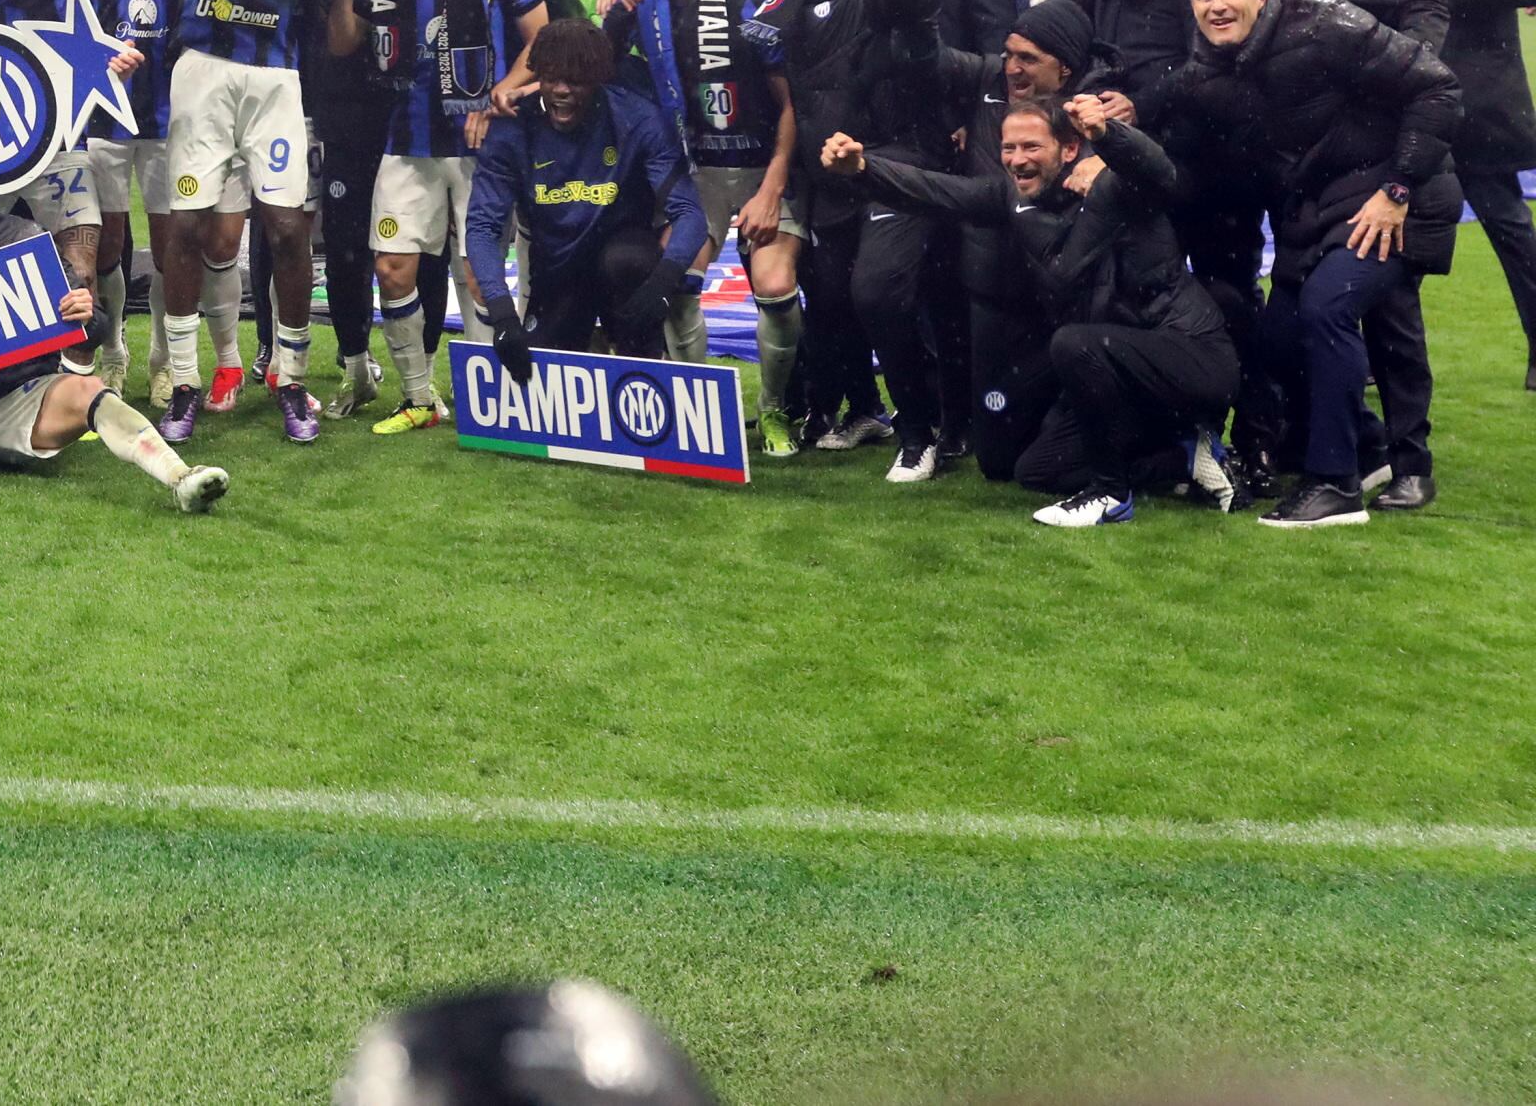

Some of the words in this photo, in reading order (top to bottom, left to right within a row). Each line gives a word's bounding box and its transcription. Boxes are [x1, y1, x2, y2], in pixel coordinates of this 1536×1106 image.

[438, 50, 454, 95] 2023-2024
[704, 88, 734, 117] 20
[267, 137, 291, 173] 9
